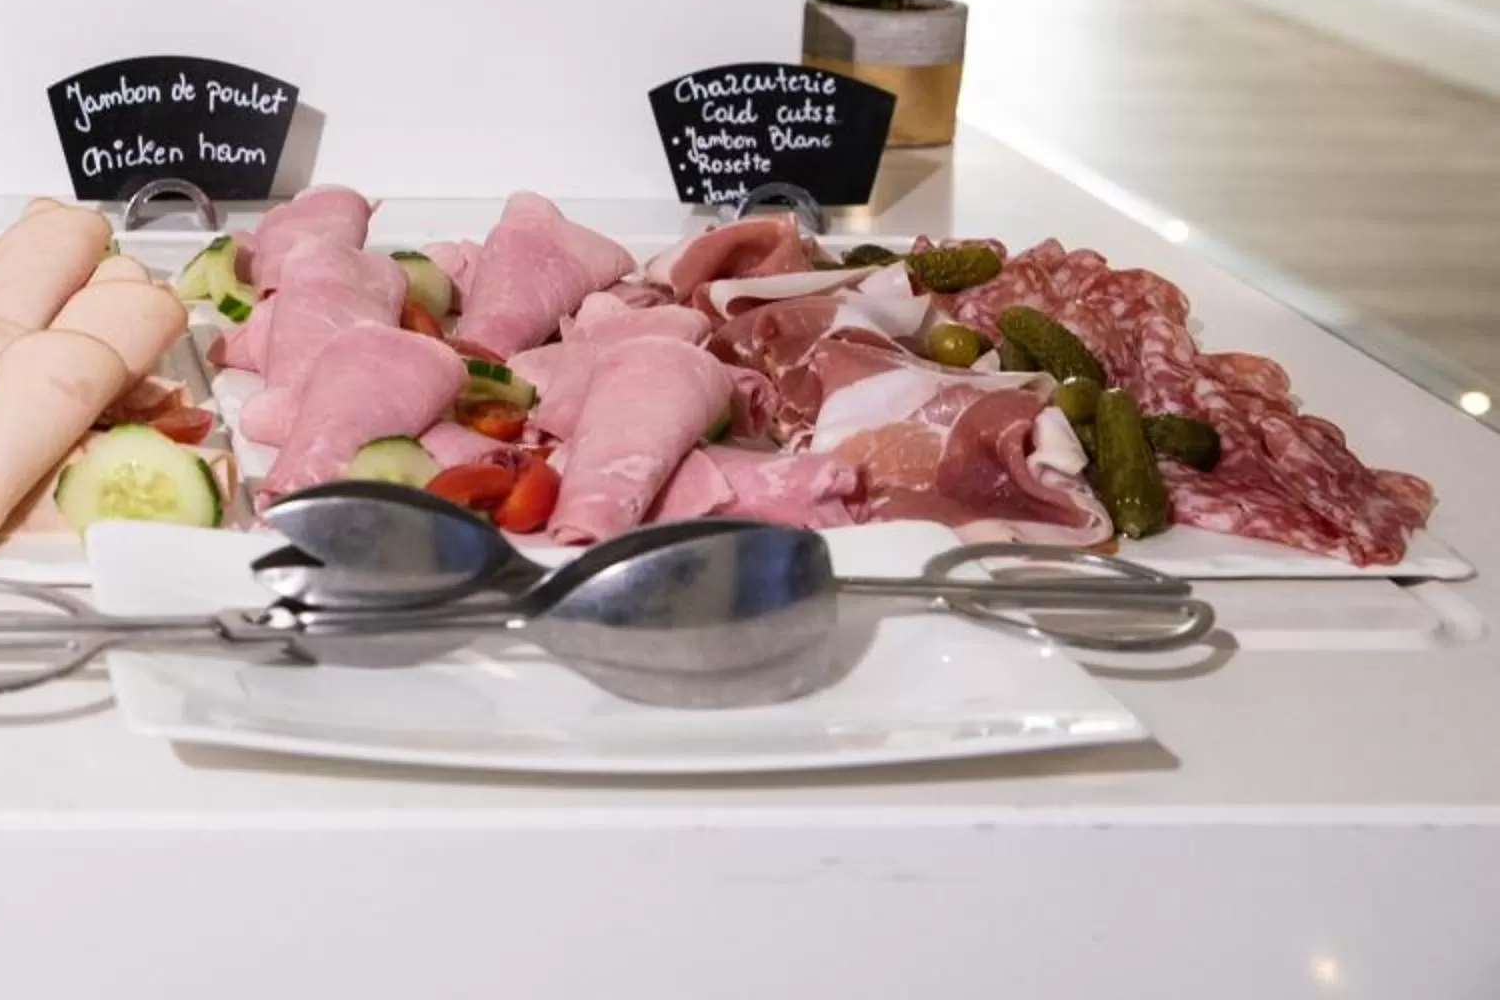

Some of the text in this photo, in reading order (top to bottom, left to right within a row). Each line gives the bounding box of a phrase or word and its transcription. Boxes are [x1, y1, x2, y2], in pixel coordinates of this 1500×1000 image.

[674, 66, 837, 102] Charcuterie
[66, 75, 161, 133] Jambon
[171, 72, 197, 101] de
[702, 98, 759, 124] Cold
[199, 132, 266, 164] ham
[685, 125, 832, 163] Jambon Blanc
[698, 151, 772, 174] Rosette
